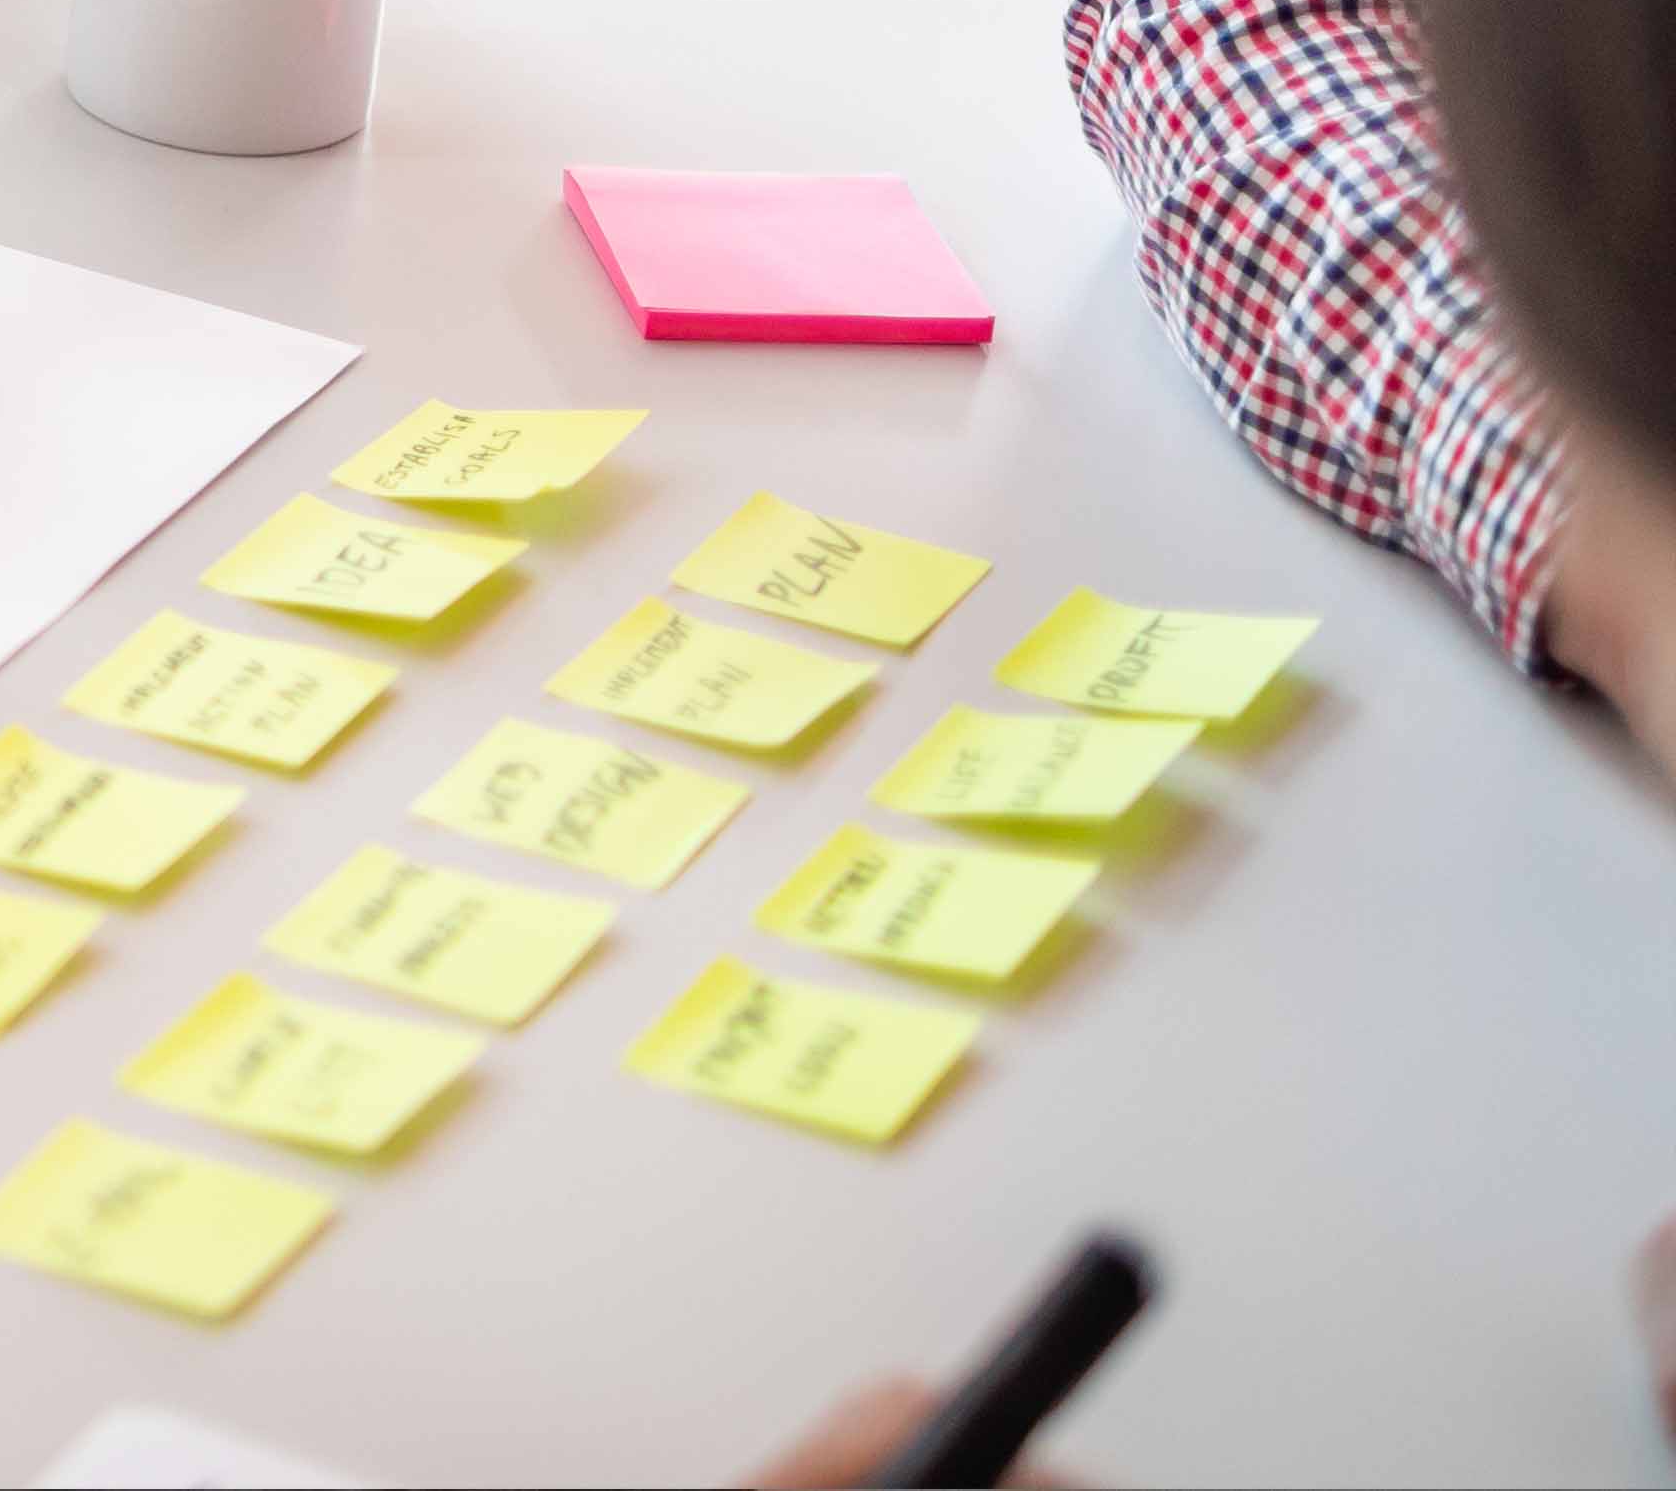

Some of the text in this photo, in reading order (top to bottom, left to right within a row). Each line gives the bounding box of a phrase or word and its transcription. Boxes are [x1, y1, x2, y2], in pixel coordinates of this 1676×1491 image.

[445, 428, 522, 488] GOALS
[296, 528, 410, 597] IDEA
[757, 513, 863, 607] PLAN
[603, 613, 695, 701] IMPLEMENT
[675, 661, 756, 723] PLAN
[1085, 614, 1180, 705] PROFIT
